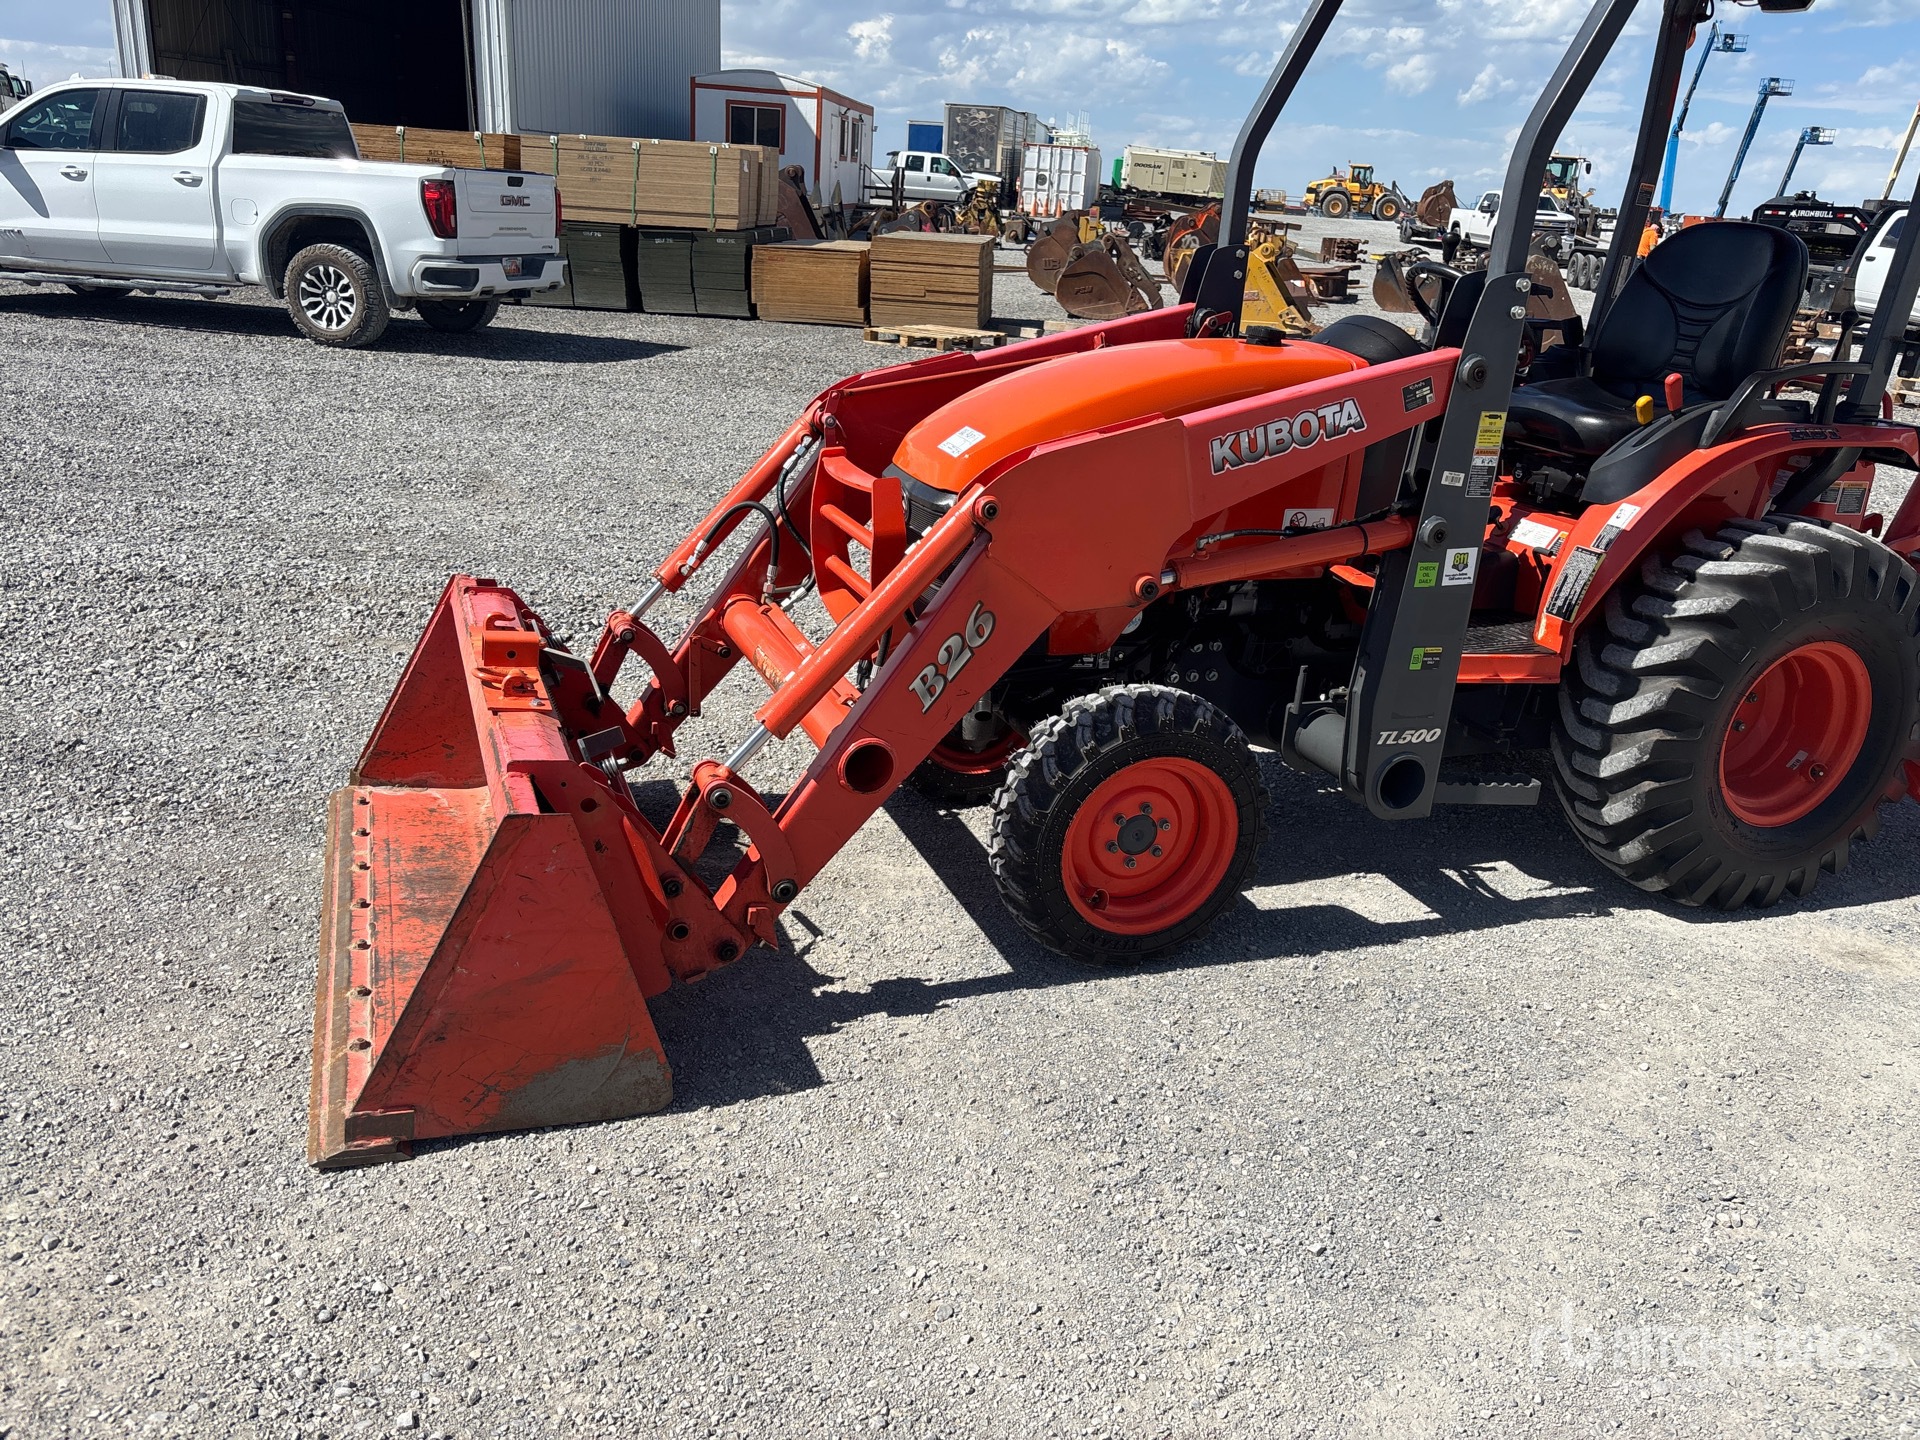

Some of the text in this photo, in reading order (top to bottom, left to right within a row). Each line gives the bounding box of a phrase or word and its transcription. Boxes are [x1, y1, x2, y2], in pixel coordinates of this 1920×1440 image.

[1133, 162, 1162, 170] DOOSAN
[500, 194, 531, 207] GMC
[1797, 210, 1833, 218] IRONBULL
[1210, 397, 1367, 475] KUBOTA
[1453, 552, 1469, 565] 811
[908, 600, 996, 714] B26
[1377, 728, 1442, 745] TL500
